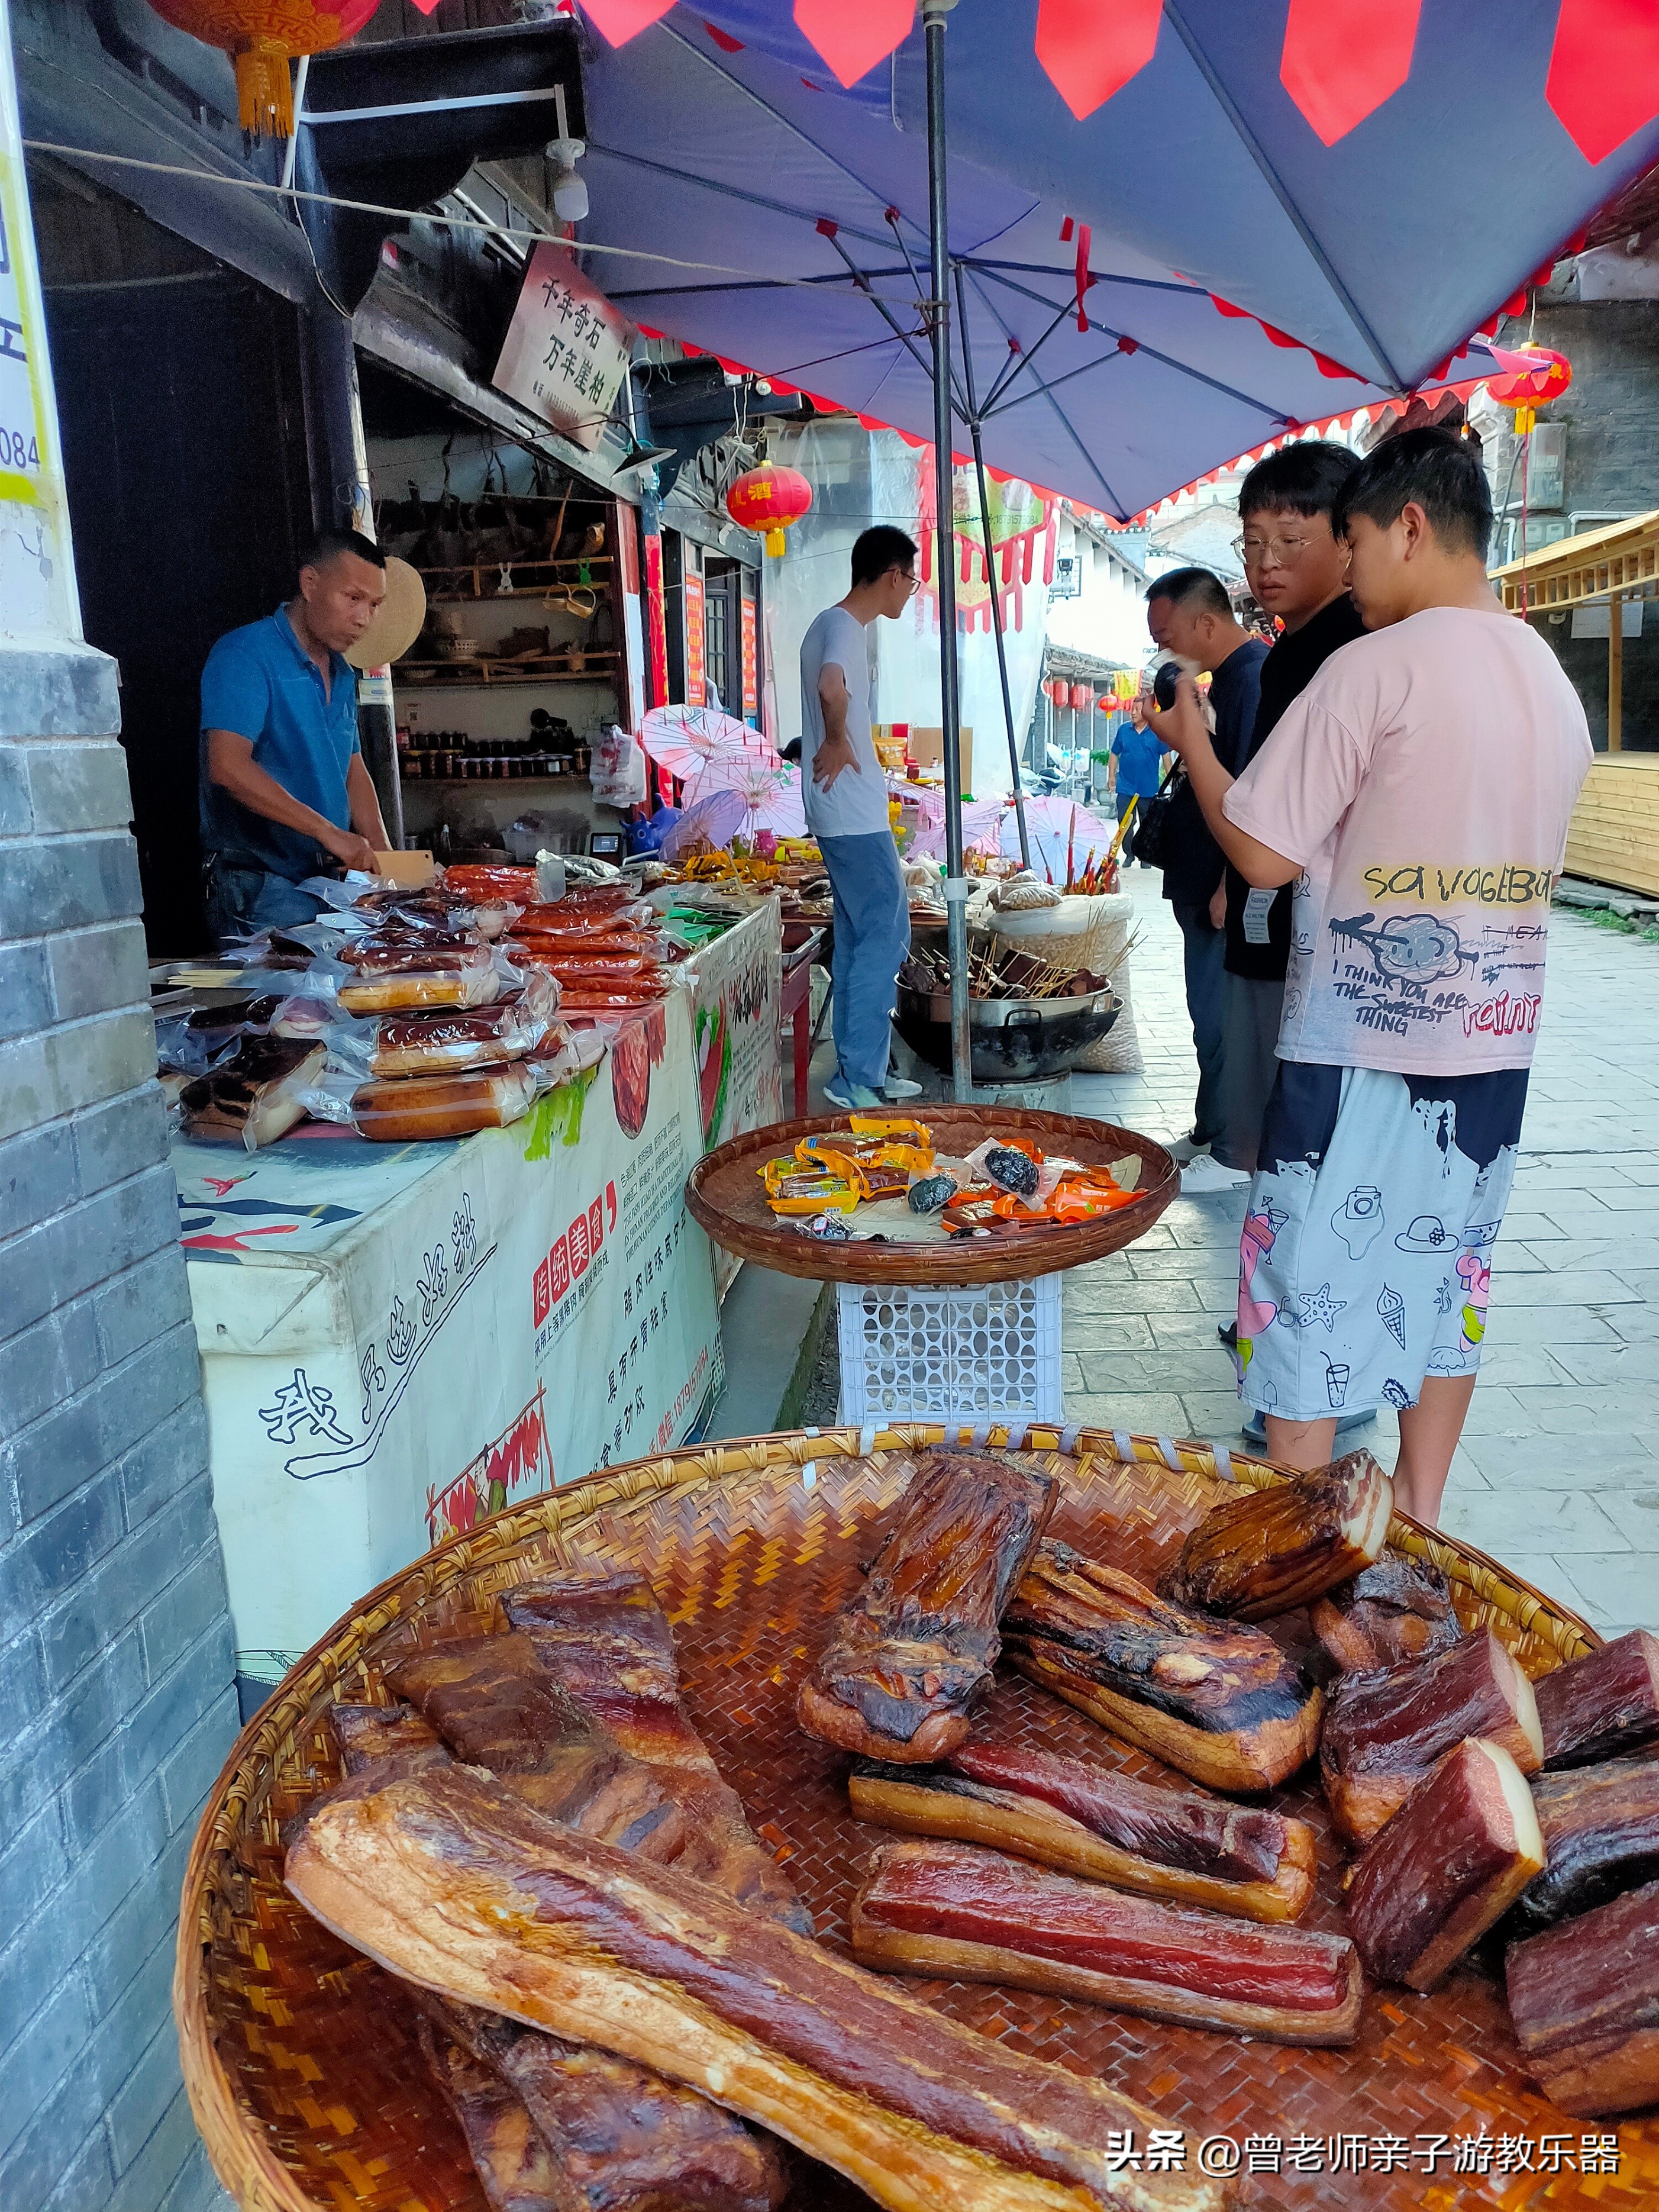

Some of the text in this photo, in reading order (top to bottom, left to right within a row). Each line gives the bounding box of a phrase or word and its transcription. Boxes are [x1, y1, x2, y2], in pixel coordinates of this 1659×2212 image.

[541, 275, 606, 350] 千年奇石
[543, 333, 605, 405] 万年崖柏
[1333, 982, 1370, 1001] THE
[1344, 965, 1393, 991] THINK
[1355, 1005, 1408, 1037] THING
[534, 1202, 603, 1321] 传统美食
[608, 1289, 669, 1404] 具有开胃祛寒
